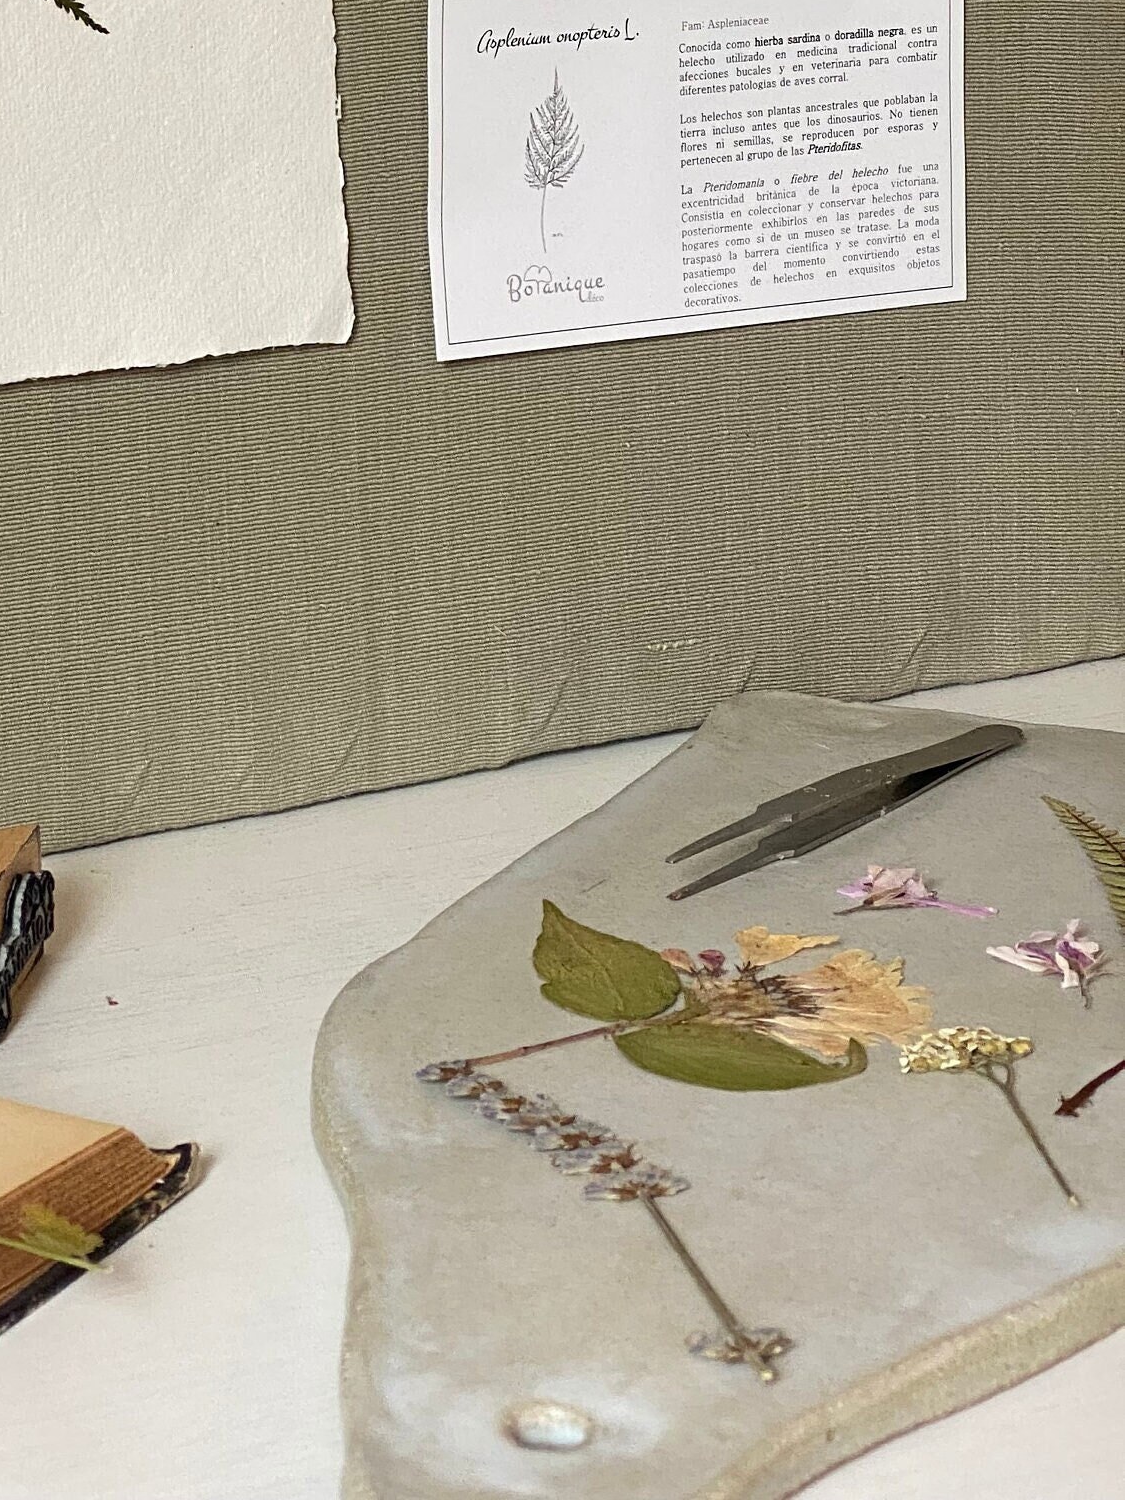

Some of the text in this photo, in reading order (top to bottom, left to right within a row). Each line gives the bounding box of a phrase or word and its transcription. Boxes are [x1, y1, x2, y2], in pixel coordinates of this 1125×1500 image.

[476, 17, 640, 59] Asplenium onopteris L.
[707, 16, 769, 30] Aspleniaceae
[678, 25, 938, 54] Conocida como hierba sardina doradilla es un
[678, 38, 938, 68] helecho utilizado en medicina tradicional contra
[679, 50, 938, 82] afecciones bucales en veterinaria para combatir
[679, 84, 727, 96] diferentes
[779, 76, 791, 87] de
[793, 77, 816, 86] aves
[679, 92, 938, 125] Los helechos son plantas ancestrales que poblaban la
[680, 127, 706, 139] tierra
[712, 124, 746, 136] incluso
[751, 121, 777, 132] antes
[783, 120, 800, 130] que
[806, 116, 821, 127] los
[889, 108, 903, 120] No
[909, 107, 938, 118] tienen
[680, 142, 708, 153] flores
[715, 137, 725, 149] ni
[782, 134, 793, 143] se
[801, 128, 855, 142] reproducen
[862, 126, 880, 137] por
[887, 122, 924, 134] esporas
[680, 154, 733, 169] pertenecen
[735, 150, 744, 162] al
[746, 150, 774, 162] grupo
[776, 146, 788, 158] de
[790, 145, 805, 156] las
[680, 163, 939, 195] La fiebre del helecho fue una
[681, 192, 745, 209] excentricidad
[808, 186, 820, 196] de
[831, 184, 840, 194] la
[730, 190, 940, 218] en coleccionar conservar helechos para
[681, 204, 940, 239] posteriormente exhibirlos en las paredes de sus
[681, 240, 719, 252] hogares
[725, 237, 751, 247] como
[756, 232, 764, 244] si
[770, 231, 782, 242] de
[787, 232, 799, 241] un
[804, 228, 835, 239] museo
[840, 226, 851, 235] se
[897, 218, 909, 229] La
[914, 215, 939, 227] moda
[728, 250, 737, 261] la
[744, 248, 779, 259] barrera
[848, 239, 859, 248] se
[912, 233, 925, 241] en
[931, 229, 940, 240] el
[682, 245, 941, 281] pasatiempo del momento convirtiendo estas
[683, 257, 940, 294] colecciones de helechos en exquisitos objetos
